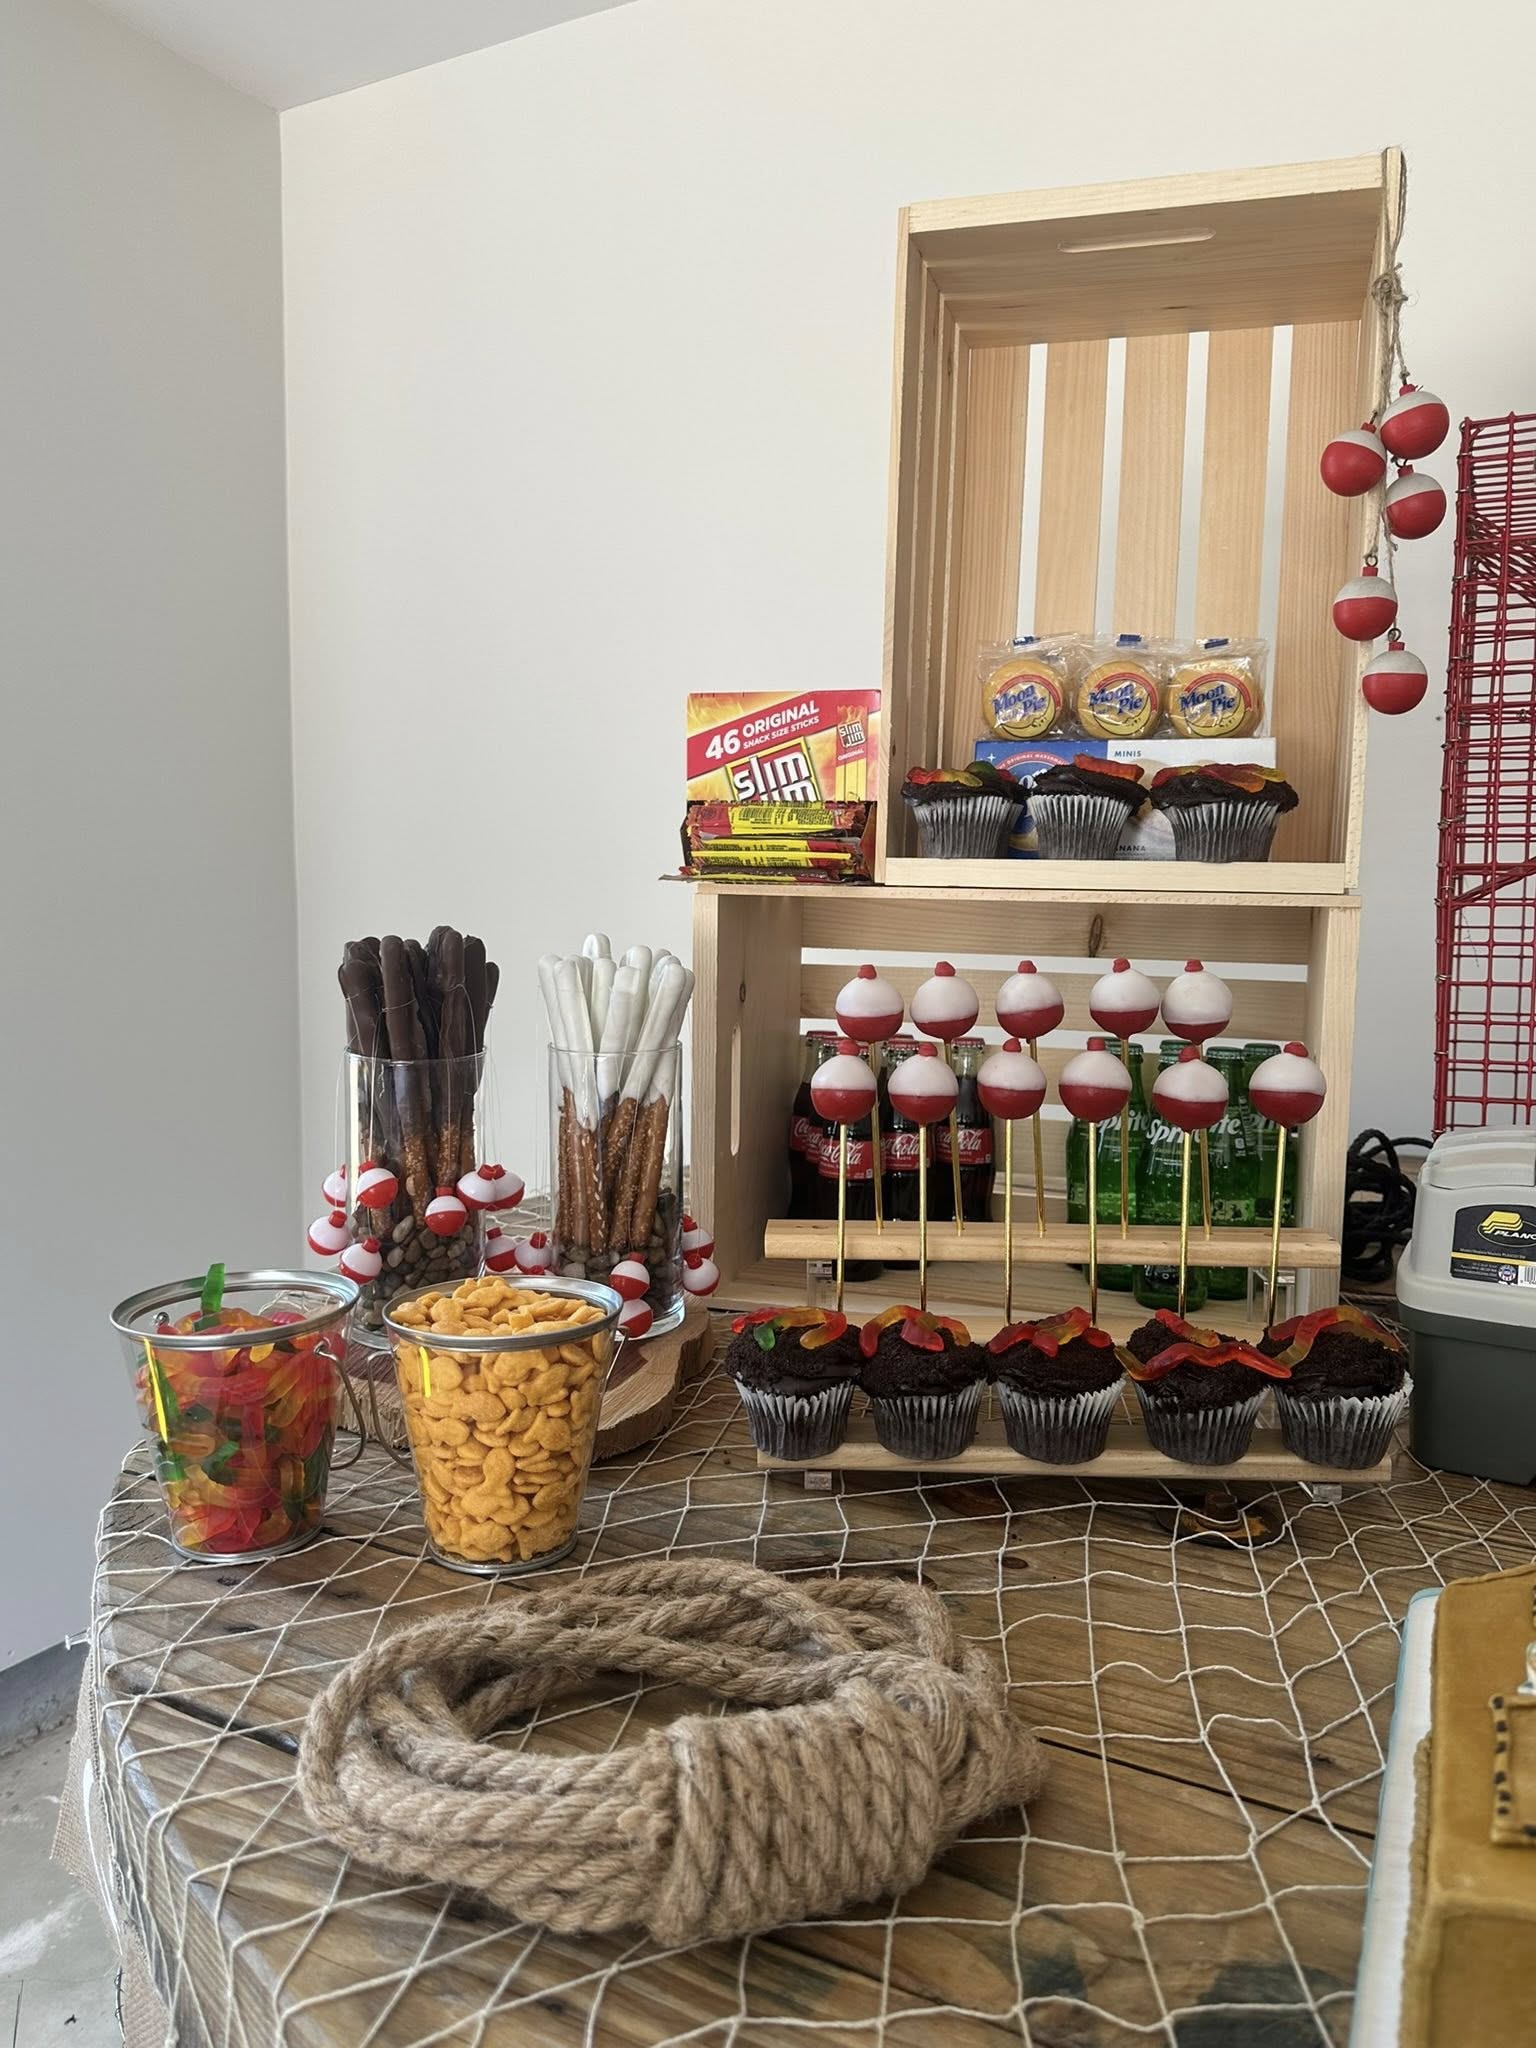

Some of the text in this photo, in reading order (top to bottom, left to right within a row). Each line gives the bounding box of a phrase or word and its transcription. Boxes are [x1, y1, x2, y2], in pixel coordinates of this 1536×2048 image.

[991, 684, 1035, 716] Moon
[1022, 696, 1047, 716] Pie
[1087, 683, 1135, 708] Moon
[1118, 697, 1143, 715] Pie
[1179, 683, 1226, 711] Moon
[1209, 696, 1236, 717] Pie
[742, 700, 820, 738] ORIGINAL
[704, 728, 741, 760] 46
[743, 715, 820, 749] SNACK SIZE STICKS
[1114, 750, 1142, 758] MINIS
[1115, 844, 1147, 852] NANA
